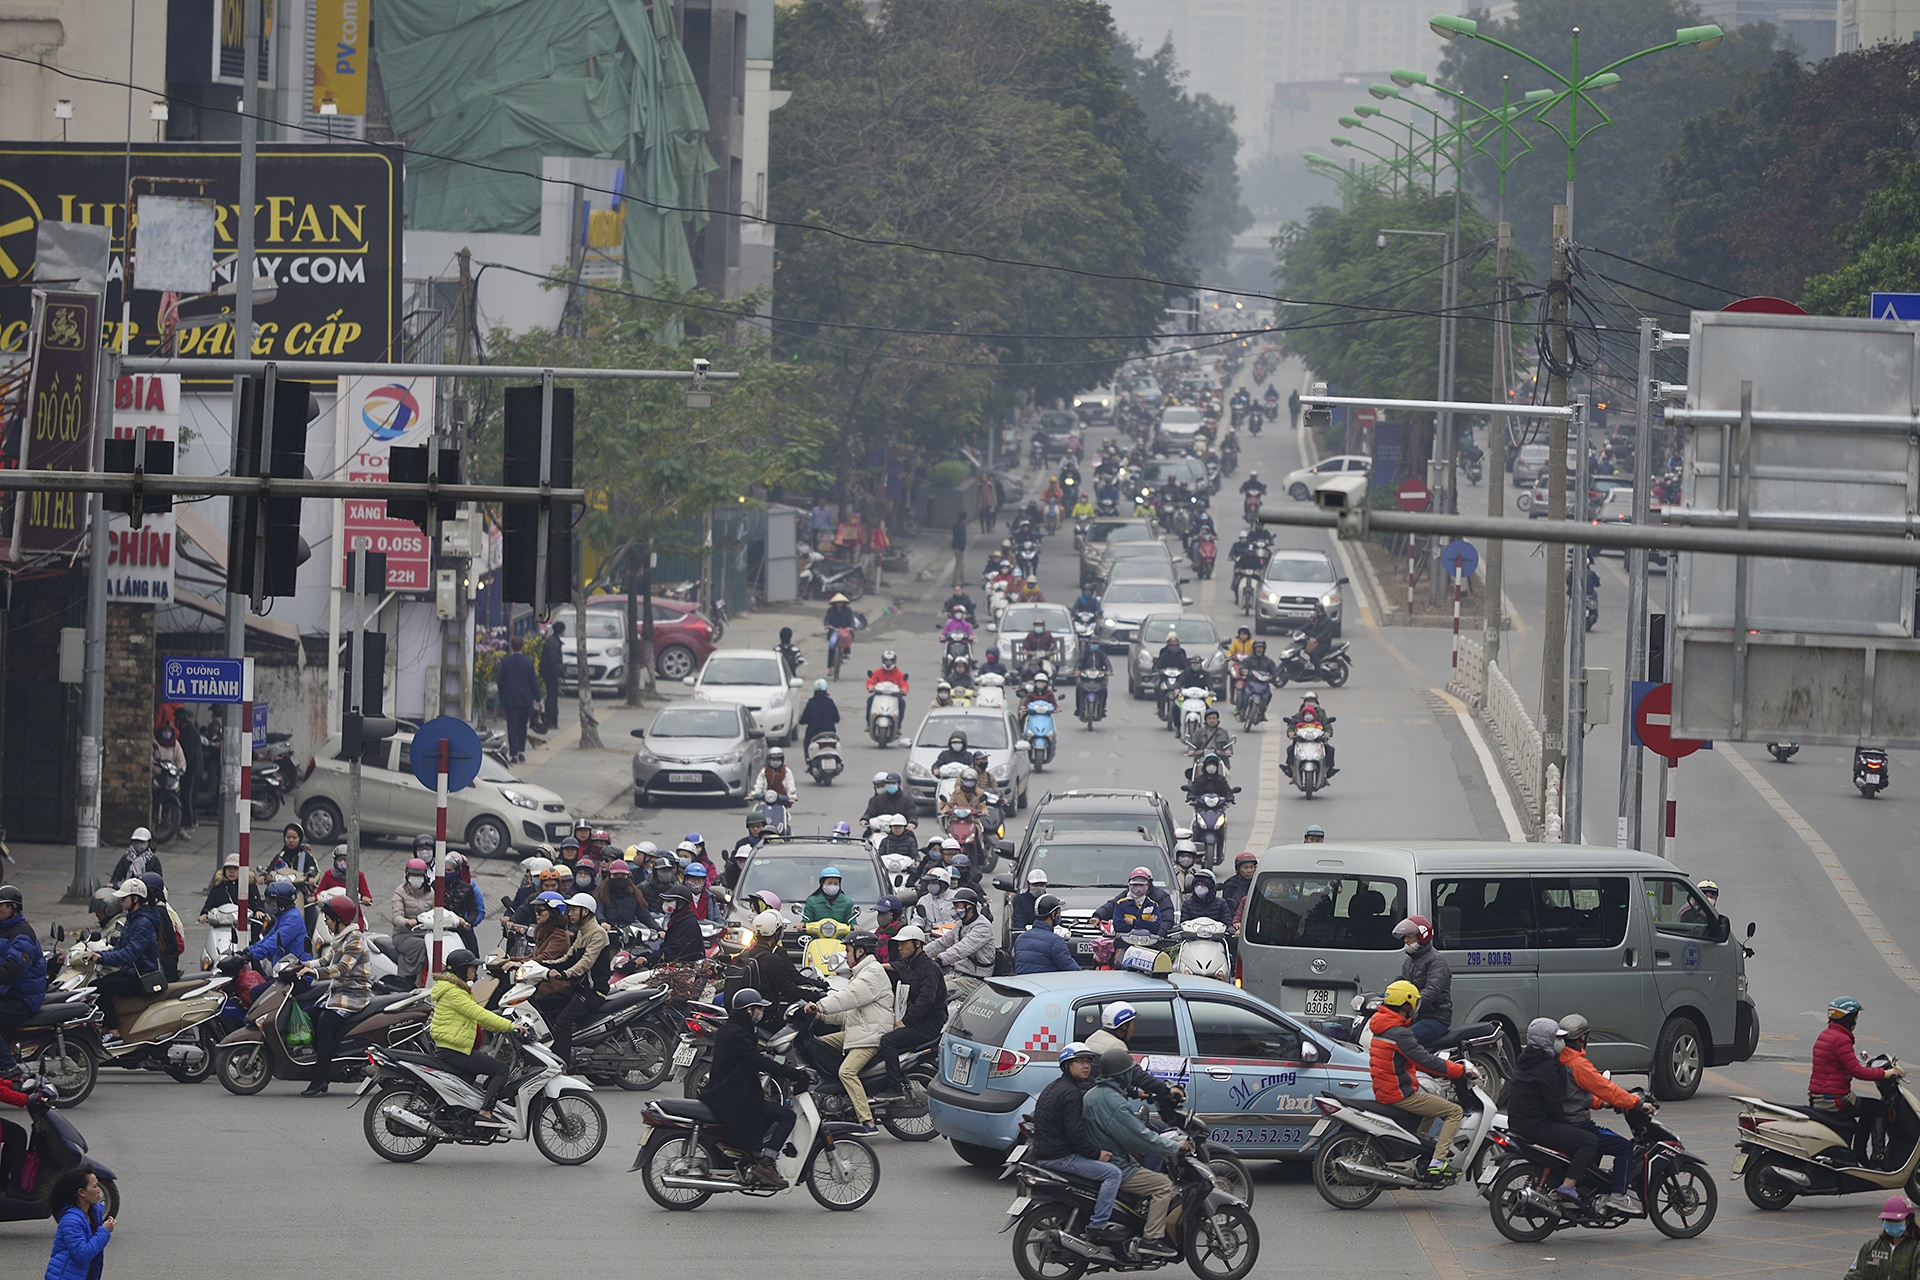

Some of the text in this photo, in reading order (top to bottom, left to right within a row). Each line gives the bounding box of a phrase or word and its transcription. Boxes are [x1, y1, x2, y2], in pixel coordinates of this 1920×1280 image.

[284, 308, 362, 356] CẤP
[115, 376, 165, 412] BIA
[350, 504, 381, 520] XĂNG
[377, 536, 422, 552] 0.05S
[388, 569, 415, 583] 22H
[117, 576, 148, 597] LÁNG
[153, 580, 169, 600] HẠ
[186, 665, 220, 676] ĐƯỜNG
[168, 677, 239, 695] LA THÀNH
[1467, 952, 1481, 965] 29B
[1487, 952, 1512, 965] 030.69
[1313, 990, 1329, 1002] 29B
[1306, 1002, 1334, 1014] 030.69
[1276, 1094, 1318, 1114] Taxi
